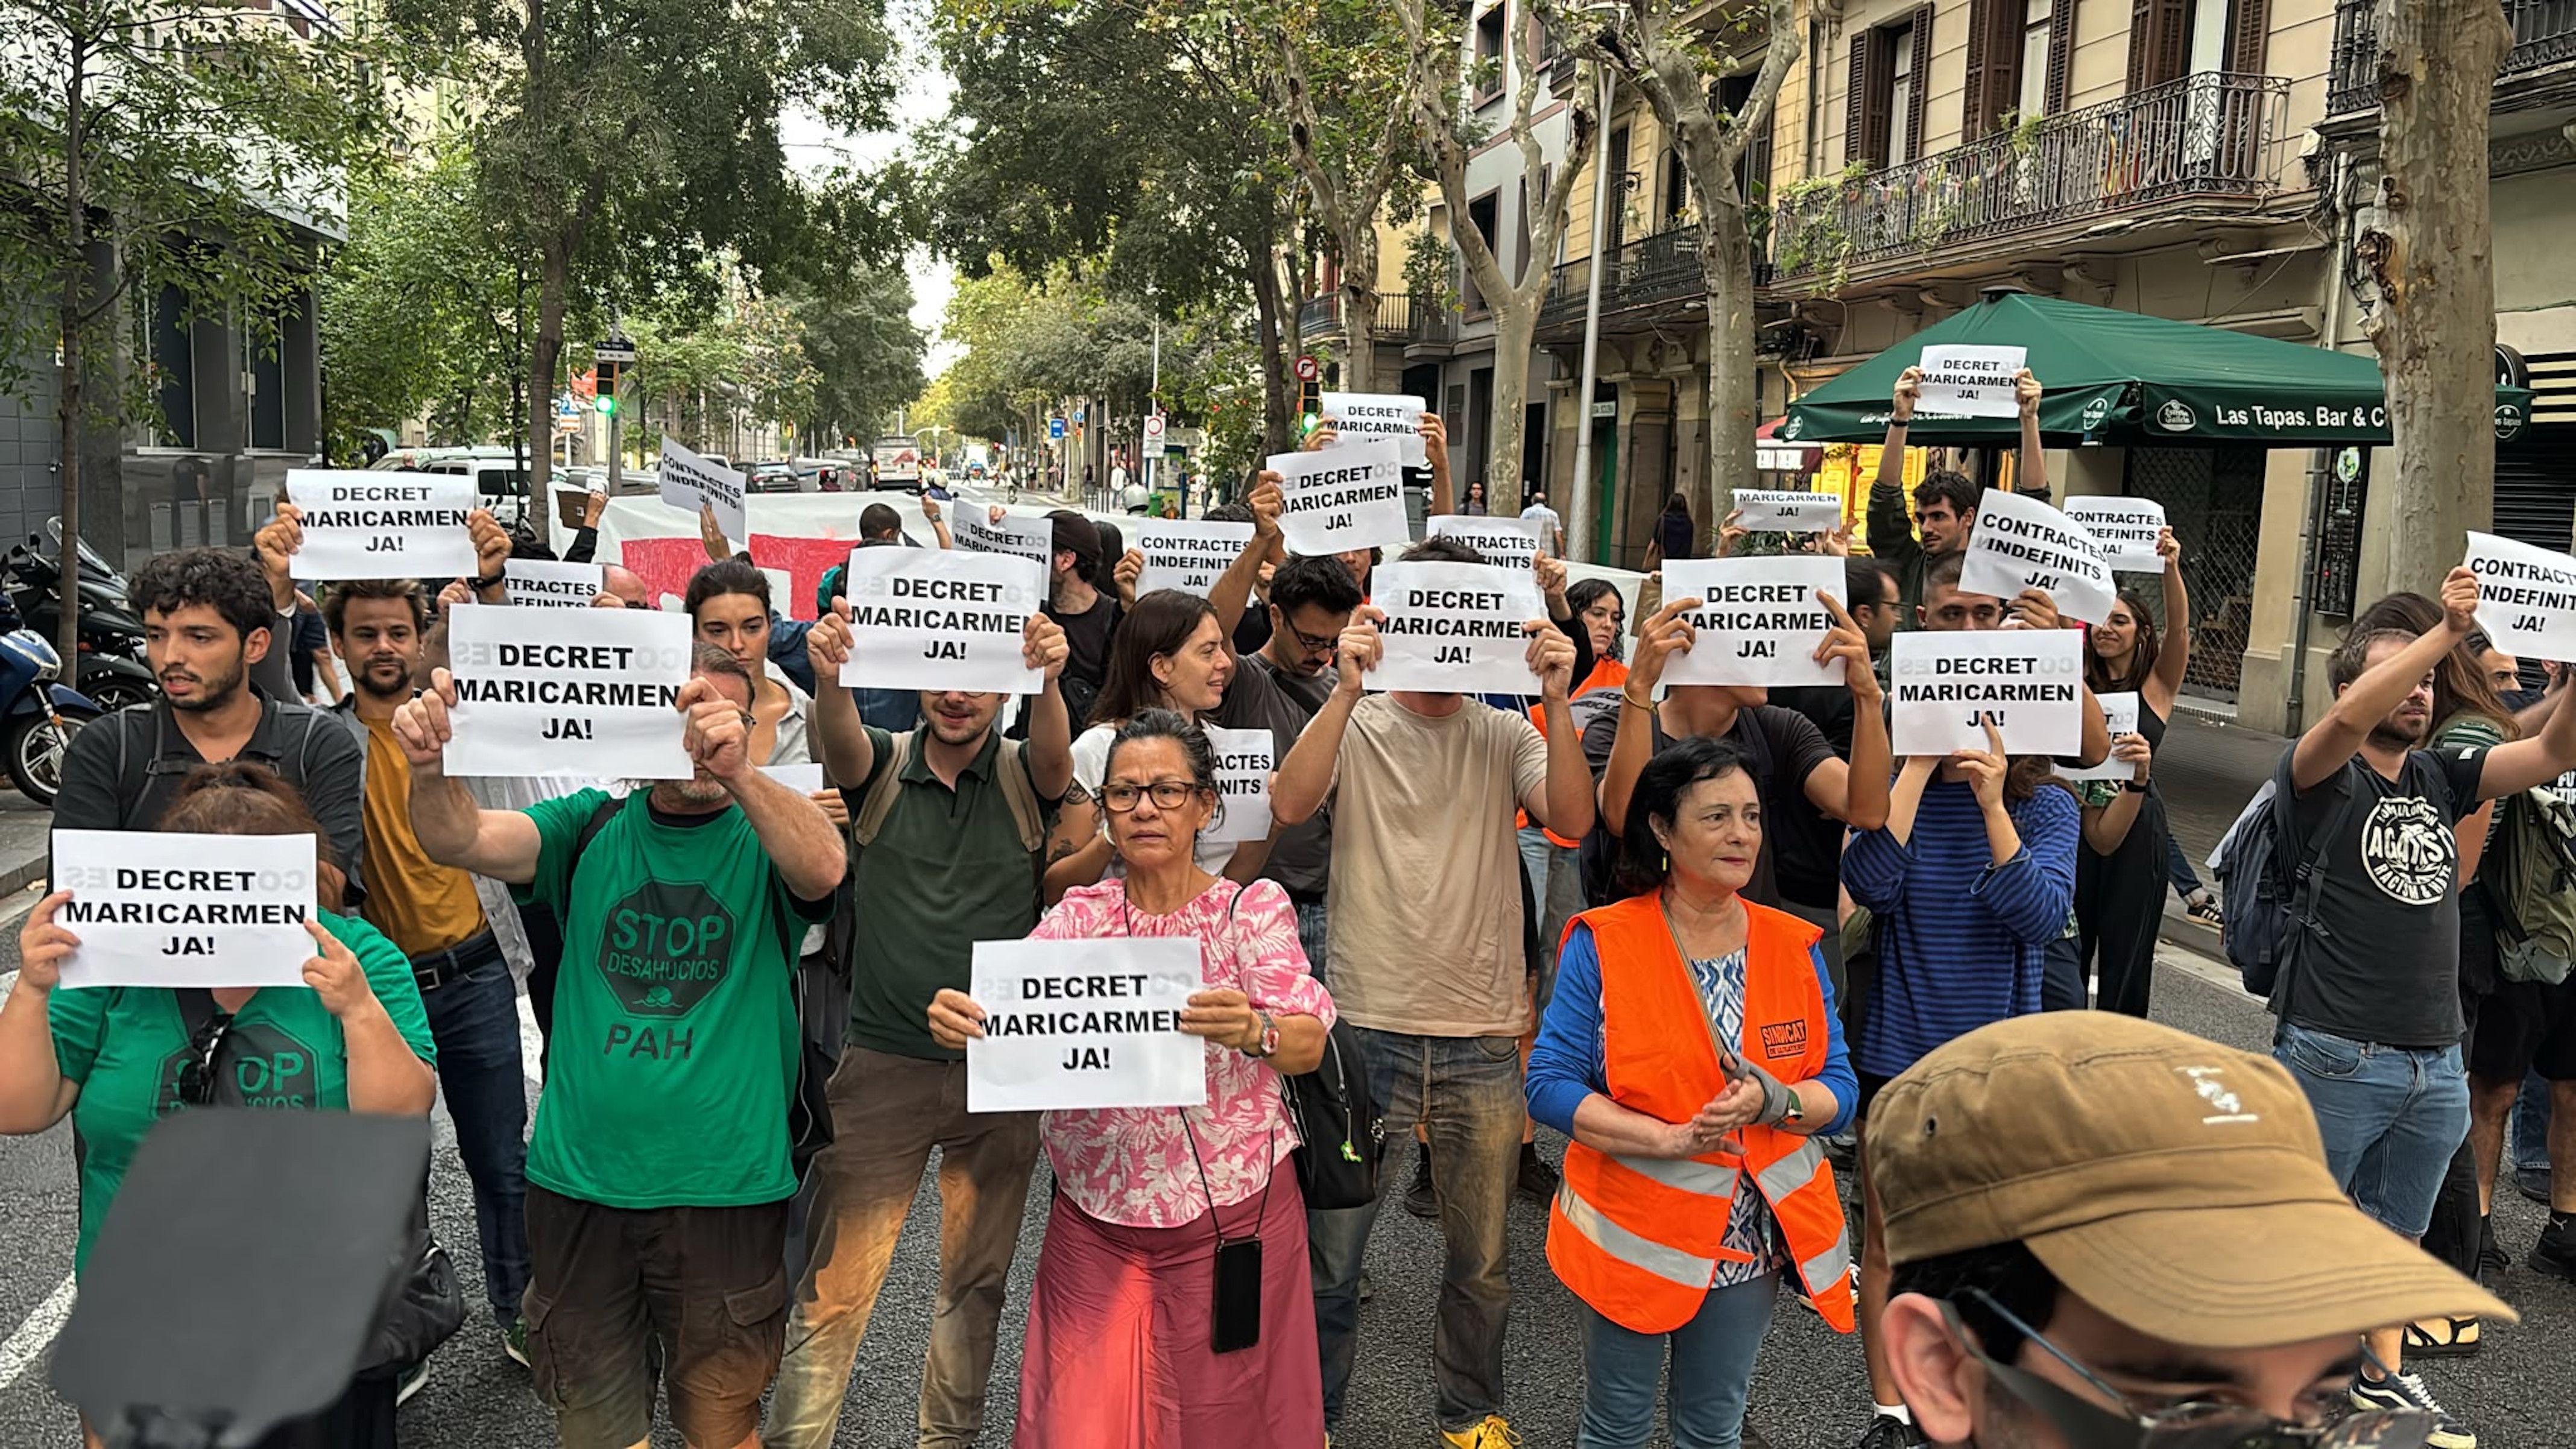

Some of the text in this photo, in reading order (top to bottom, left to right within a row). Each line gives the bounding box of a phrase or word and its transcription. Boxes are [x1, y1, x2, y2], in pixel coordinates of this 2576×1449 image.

[1943, 360, 2000, 371] DECRET
[1922, 374, 2018, 387] MARICARMEN
[1957, 390, 1978, 399] JA!
[1348, 406, 1402, 417] DECRET
[2216, 405, 2247, 426] Las
[2252, 406, 2311, 430] Tapas.
[2317, 406, 2347, 426] Bar
[2352, 407, 2367, 427] &
[663, 452, 741, 499] CONTRACTES
[1300, 466, 1372, 488] DECRET
[333, 488, 431, 500] DECRET
[666, 472, 737, 509] INDEFINITS
[299, 509, 467, 528] MARICARMEN
[1325, 514, 1352, 529] JA!
[1777, 507, 1798, 516] JA!
[366, 537, 403, 551] JA!
[970, 524, 1023, 546] DECRET
[1982, 513, 2107, 563] CONTRACTES
[1986, 537, 2101, 579] INDEFINITS
[894, 578, 1002, 602] DECRET
[1184, 575, 1207, 586] JA!
[2024, 572, 2059, 591] JA!
[1409, 590, 1504, 610] DECRET
[1708, 586, 1807, 602] DECRET
[2512, 615, 2545, 632] JA!
[499, 645, 633, 669] DECRET
[924, 641, 965, 659] JA!
[1434, 646, 1471, 663] JA!
[1737, 641, 1775, 657] JA!
[1936, 658, 2037, 674] DECRET
[454, 678, 680, 707] MARICARMEN
[1901, 684, 2073, 701] MARICARMEN
[542, 719, 592, 739] JA!
[118, 870, 255, 891] DECRET
[2373, 863, 2452, 900] RACISM & HATE
[66, 901, 305, 924] MARICARMEN
[613, 909, 725, 957] STOP
[162, 937, 214, 955] JA!
[607, 954, 720, 982] DESAHUCIOS
[1023, 975, 1147, 999] DECRET
[604, 1023, 693, 1061] PAH
[1063, 1048, 1110, 1069] JA!
